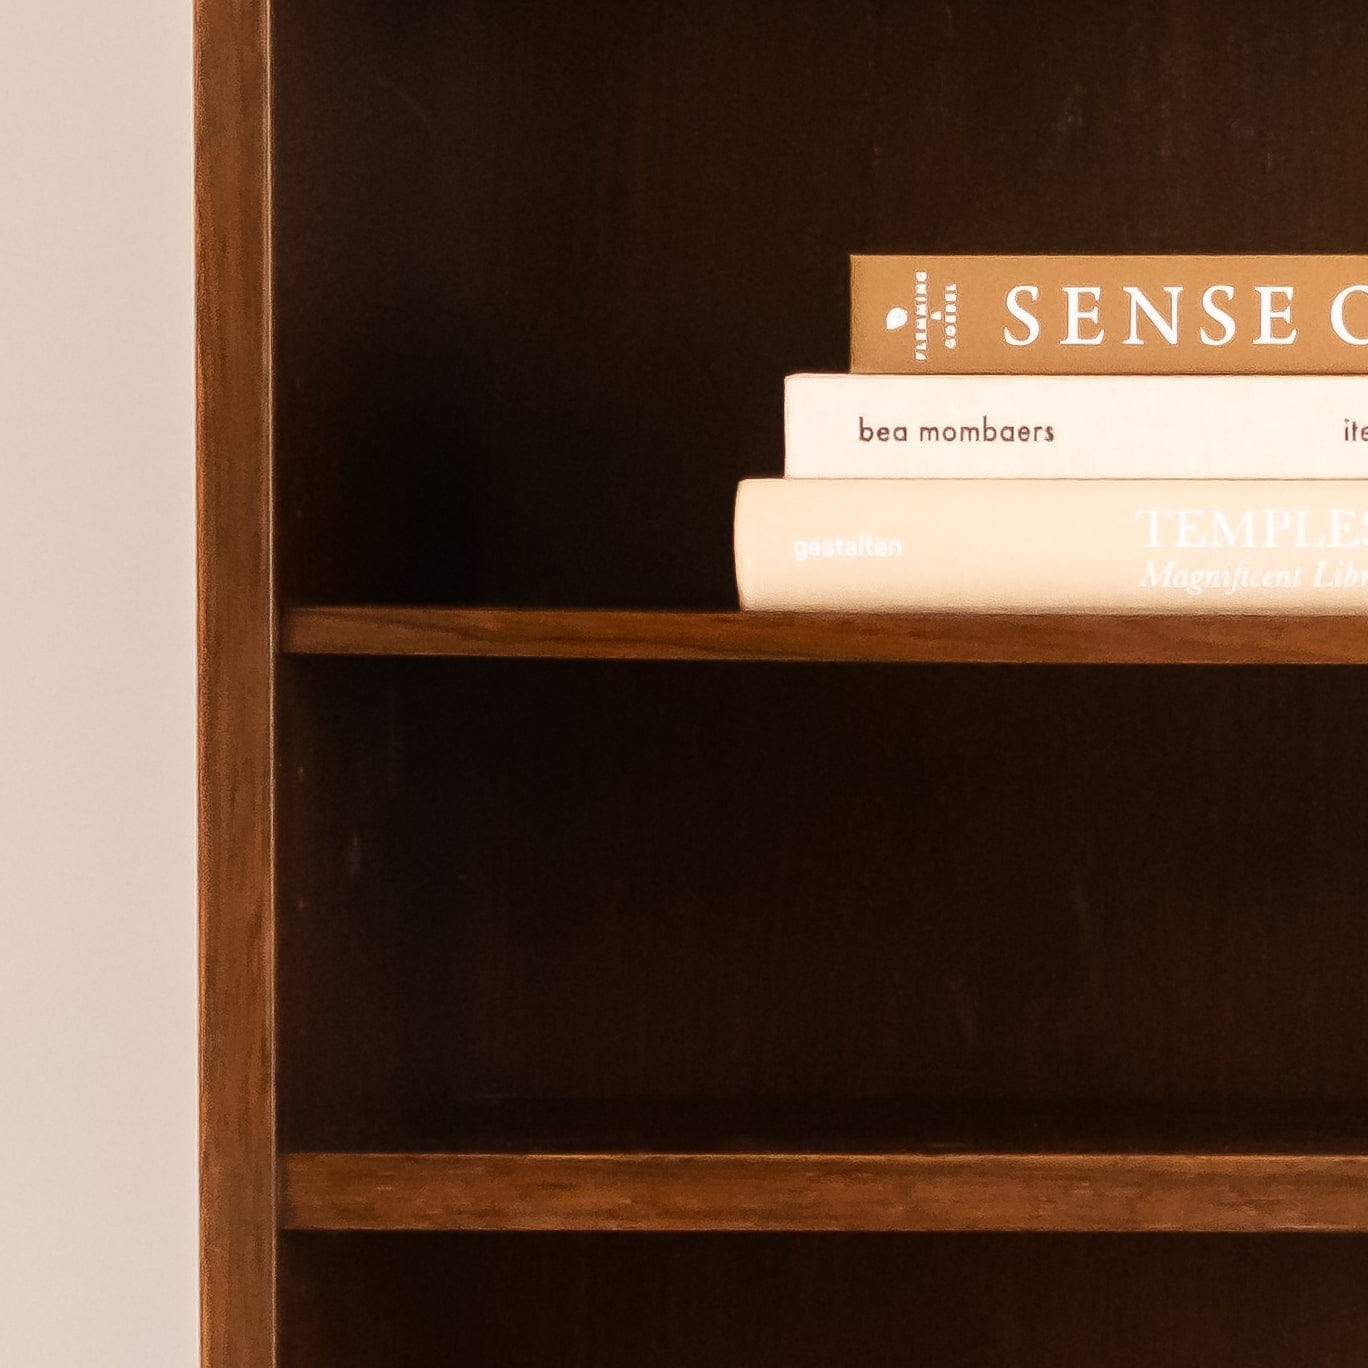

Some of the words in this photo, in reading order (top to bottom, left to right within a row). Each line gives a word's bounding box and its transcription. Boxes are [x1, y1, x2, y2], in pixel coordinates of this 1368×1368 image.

[1003, 284, 1298, 347] SENSE
[858, 415, 909, 444] bea
[918, 415, 1056, 444] mombaers
[792, 534, 903, 563] gestalten
[1138, 559, 1301, 596] Magnificent
